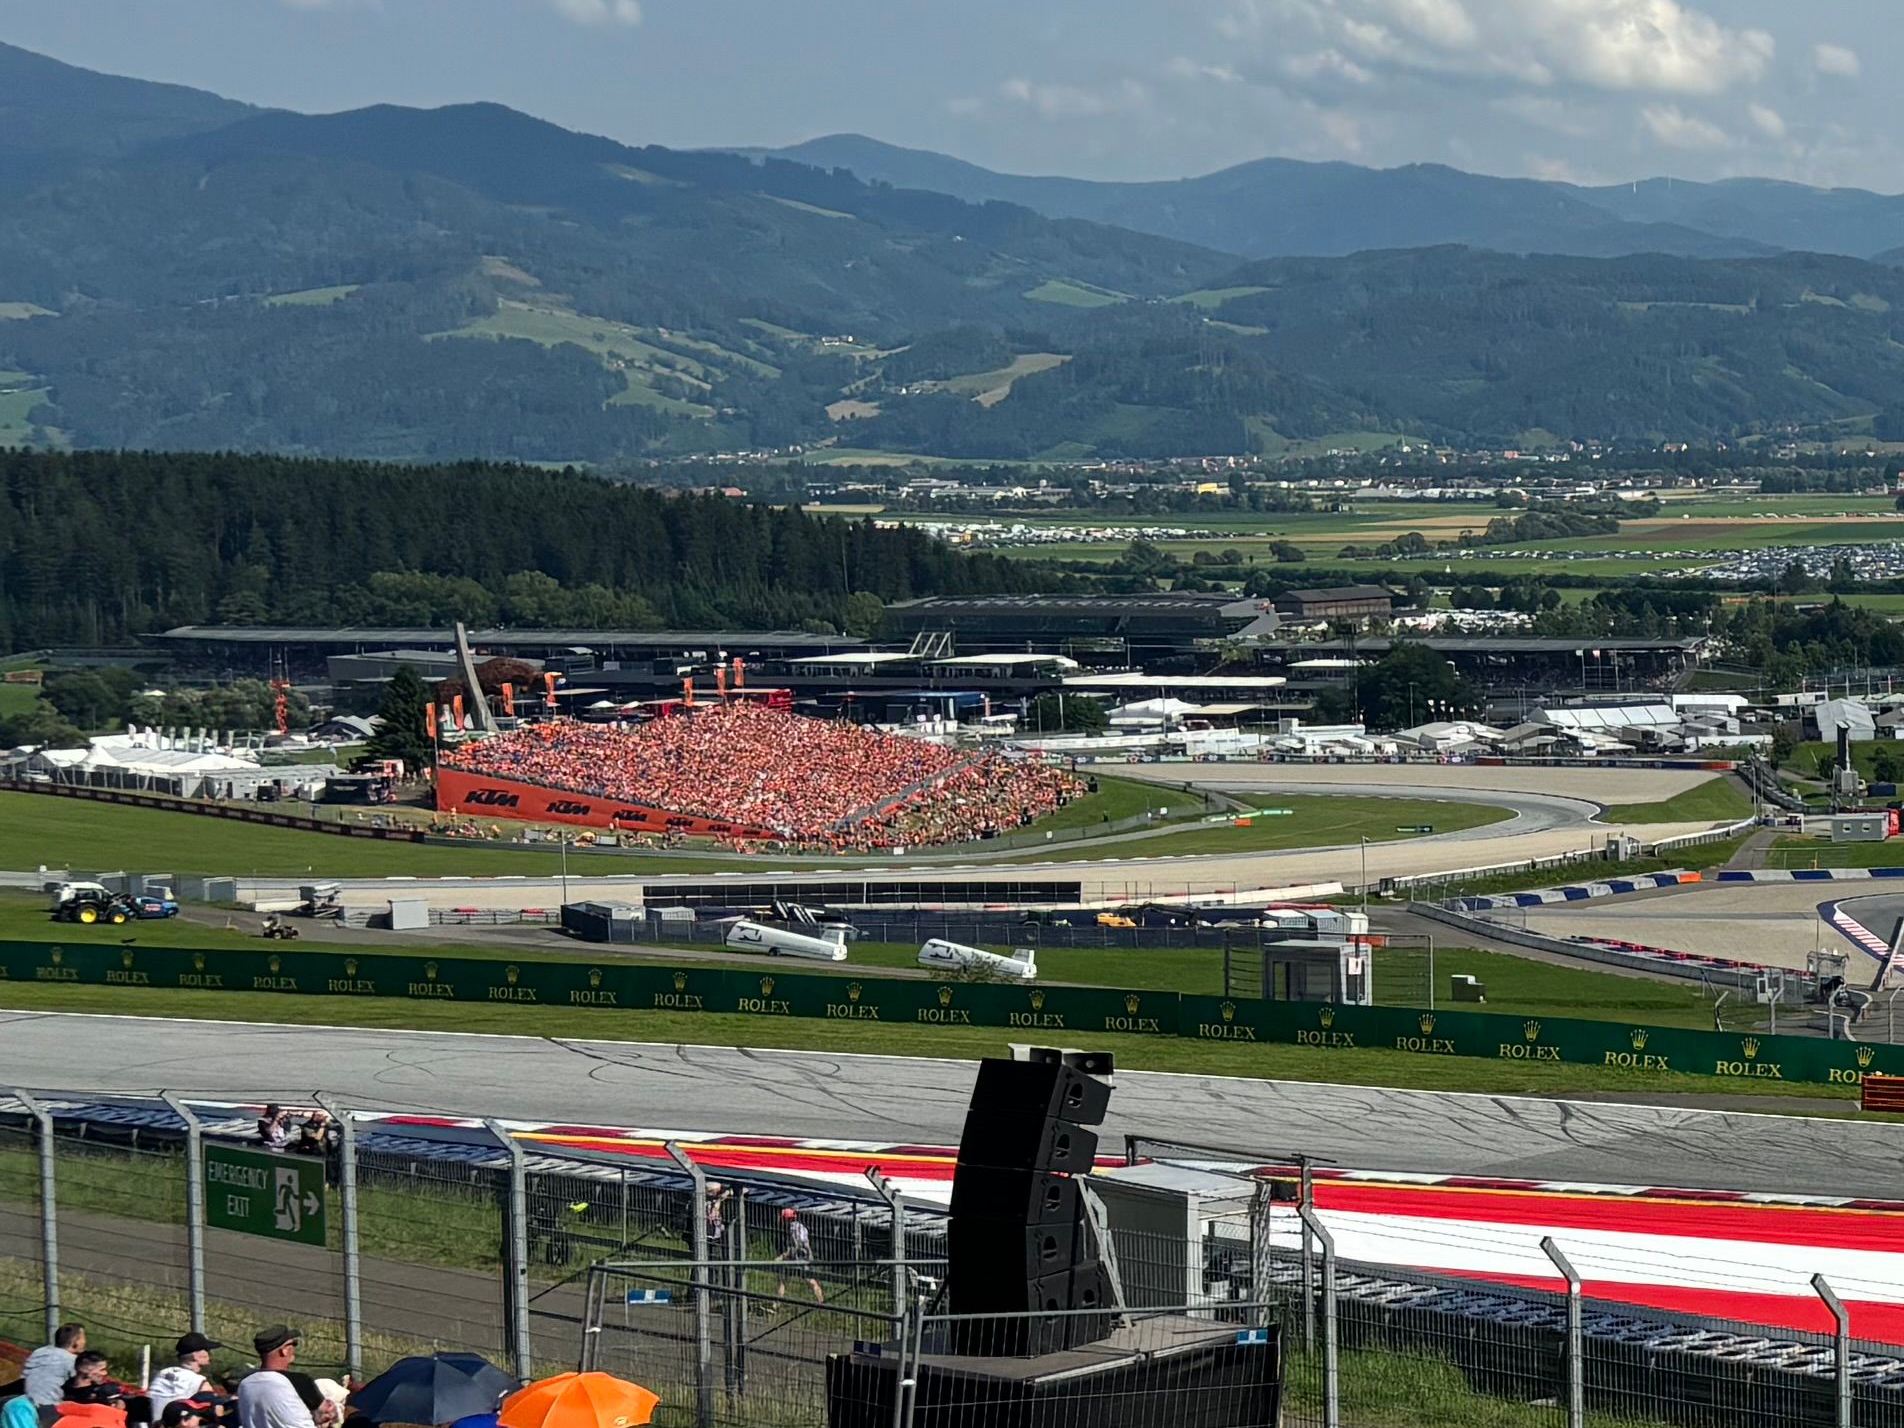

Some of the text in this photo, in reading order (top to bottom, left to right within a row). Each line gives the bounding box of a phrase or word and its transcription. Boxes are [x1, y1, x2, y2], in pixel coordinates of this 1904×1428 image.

[464, 788, 520, 807] KTM
[546, 800, 592, 816] KTM
[612, 809, 648, 822] KTM
[328, 979, 375, 993] ROLEX
[409, 983, 454, 997] ROLEX
[489, 986, 536, 1001] ROLEX
[570, 990, 617, 1005] ROLEX
[654, 993, 703, 1008] ROLEX
[738, 998, 790, 1014] ROLEX
[827, 1004, 879, 1019] ROLEX
[918, 1008, 970, 1023] ROLEX
[1010, 1012, 1064, 1028] ROLEX
[1105, 1017, 1159, 1032] ROLEX
[1200, 1024, 1256, 1040] ROLEX
[1298, 1030, 1354, 1047] ROLEX
[1396, 1036, 1456, 1054] ROLEX
[1500, 1044, 1560, 1060] ROLEX
[1604, 1051, 1668, 1070] ROLEX
[1716, 1060, 1782, 1078] ROLEX
[1829, 1069, 1863, 1083] ROL
[208, 1160, 269, 1189] EMERGENCY
[227, 1194, 250, 1218] EXIT
